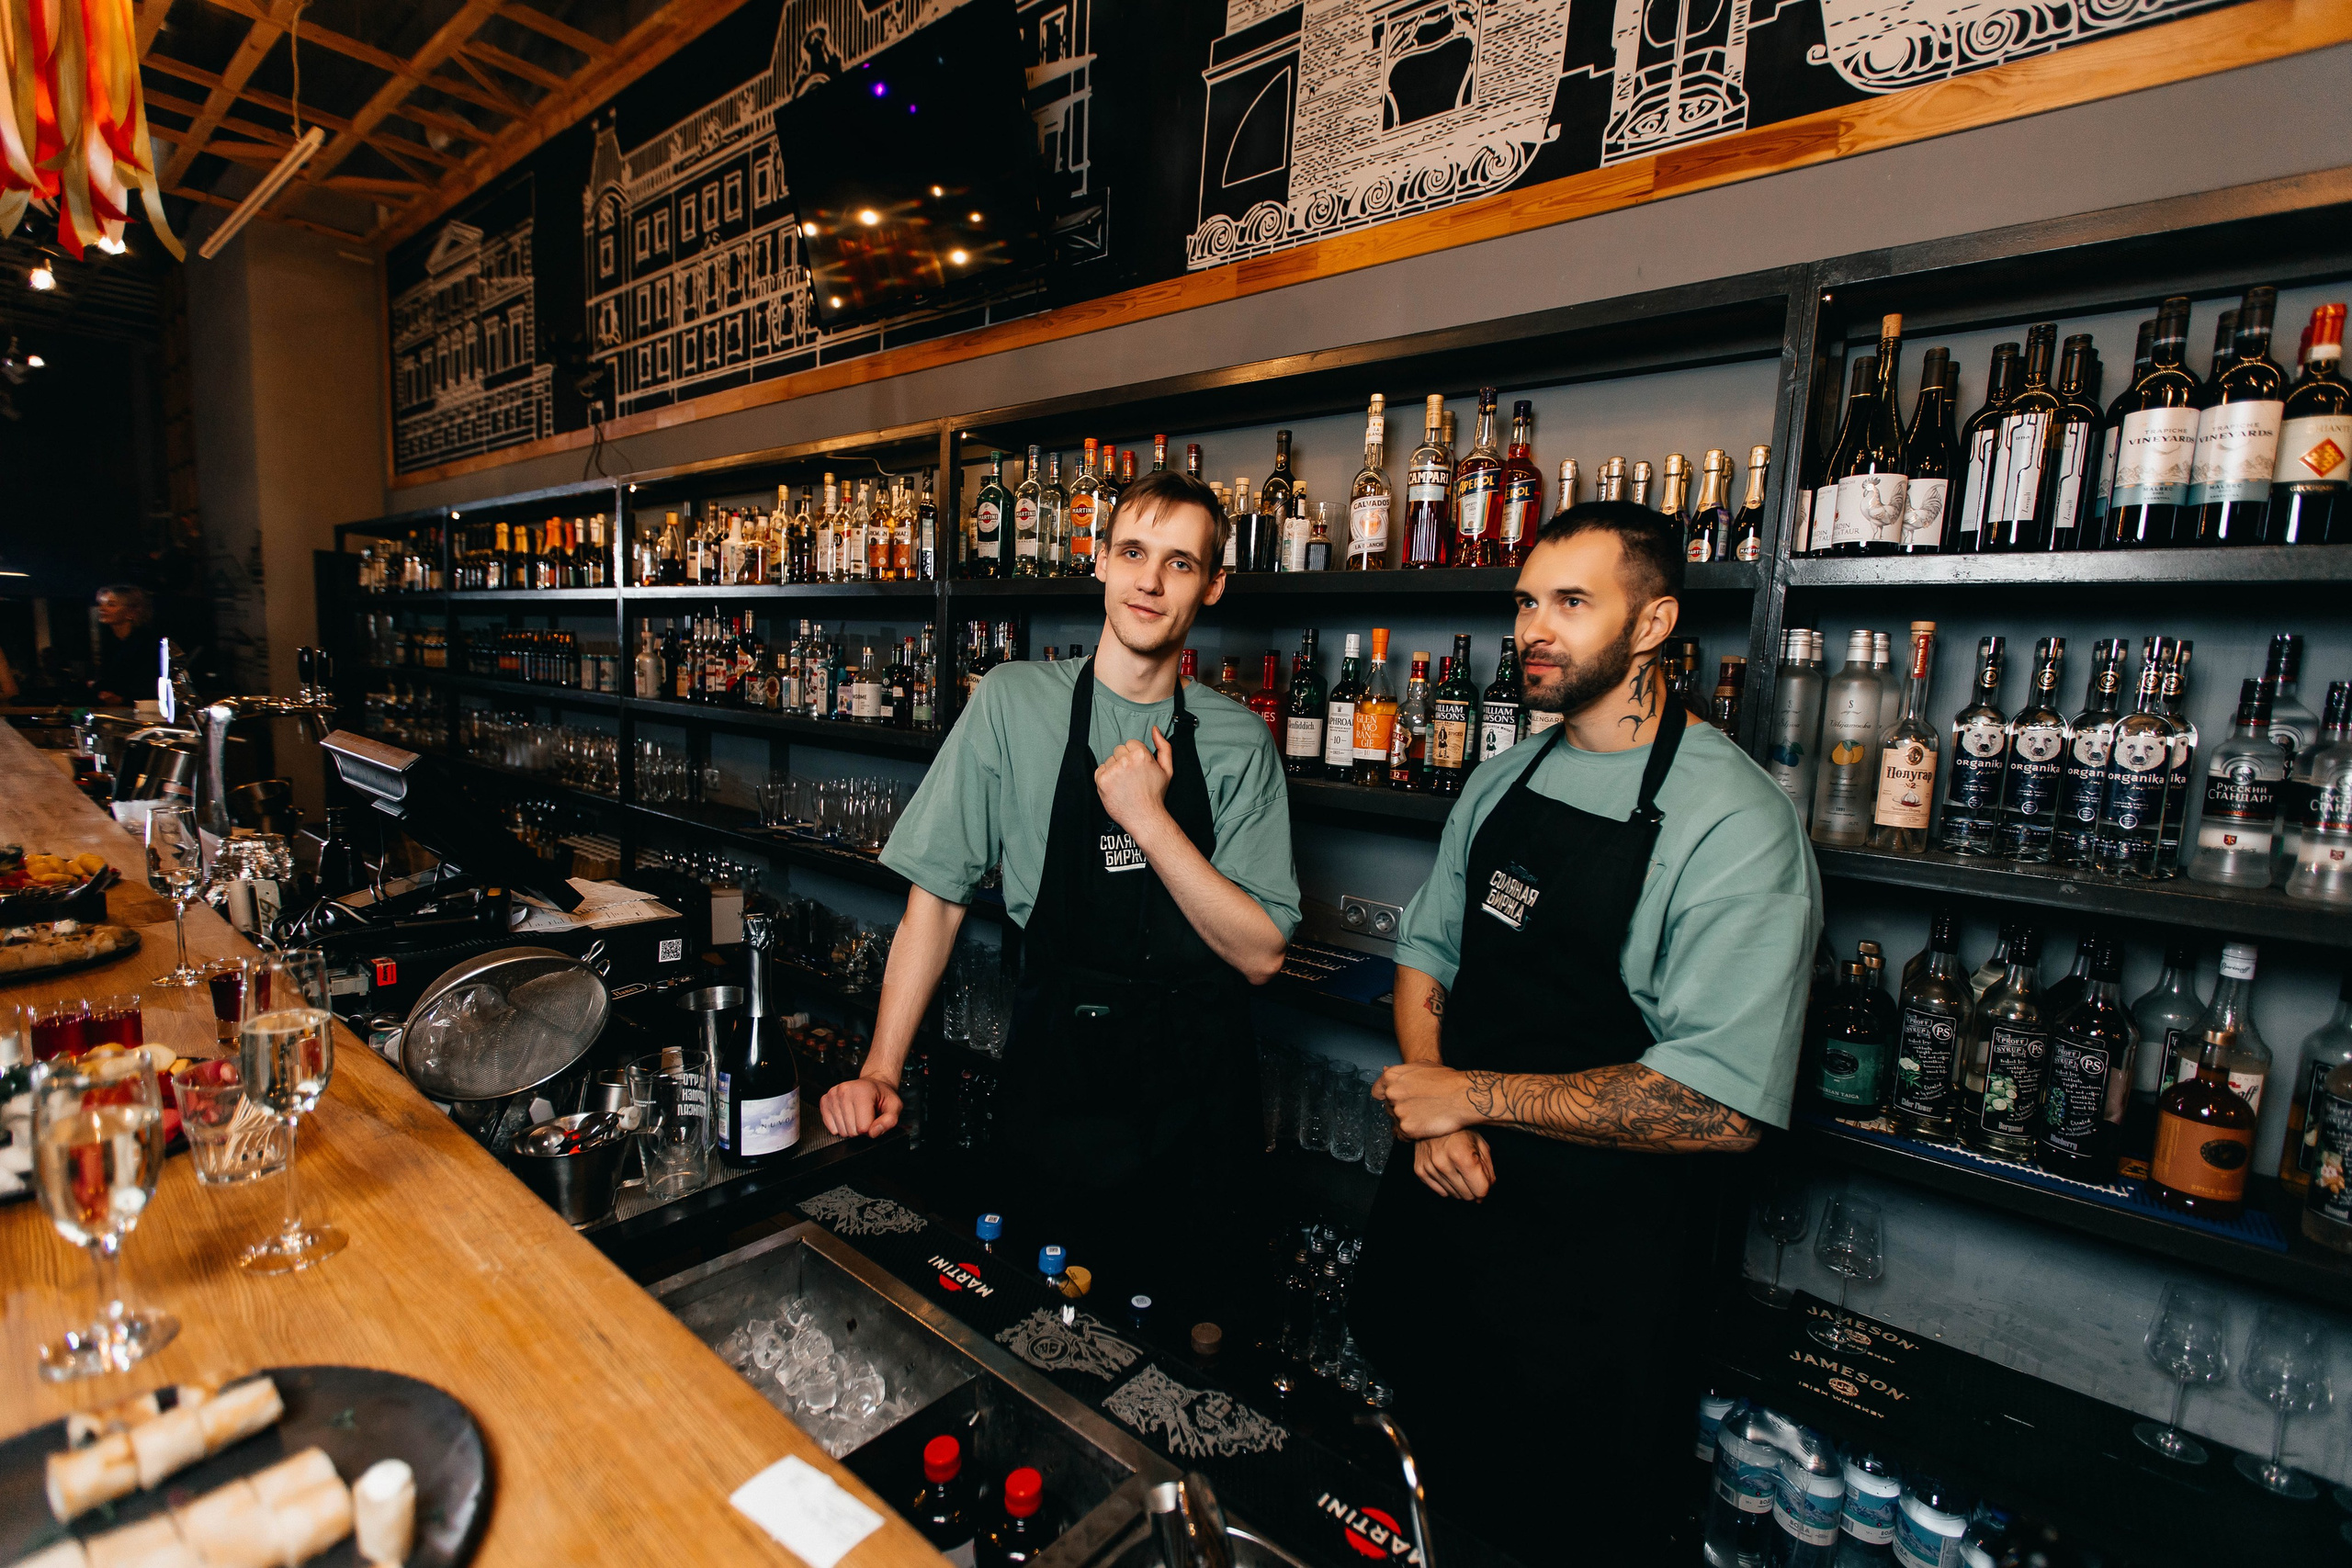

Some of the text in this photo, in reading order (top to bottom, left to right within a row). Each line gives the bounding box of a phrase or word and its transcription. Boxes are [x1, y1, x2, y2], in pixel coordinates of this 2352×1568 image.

[2212, 423, 2260, 432] TRAPICHE
[2129, 435, 2195, 446] VINEYARDS
[2199, 429, 2274, 443] VINEYARDS
[1408, 471, 1449, 485] CAMPARI
[1353, 499, 1390, 510] CALVADOS
[1329, 717, 1353, 727] PHROA
[1357, 715, 1377, 724] GLEN
[1356, 730, 1372, 739] RAN
[1363, 724, 1377, 732] MO
[1334, 736, 1340, 744] 10
[1361, 739, 1374, 748] GIE
[1887, 766, 1933, 783] Полугар
[1100, 833, 1139, 851] СОЛЯ
[1105, 849, 1147, 866] БИРЖ
[1489, 870, 1540, 908] СОЛЯНАЯ
[1485, 887, 1525, 922] БИРЖА
[927, 1255, 994, 1299] MARTINI
[1806, 1305, 1916, 1350] JAMESON
[1790, 1350, 1905, 1401] JAMESON
[1798, 1381, 1884, 1418] IRISH WHISKEY
